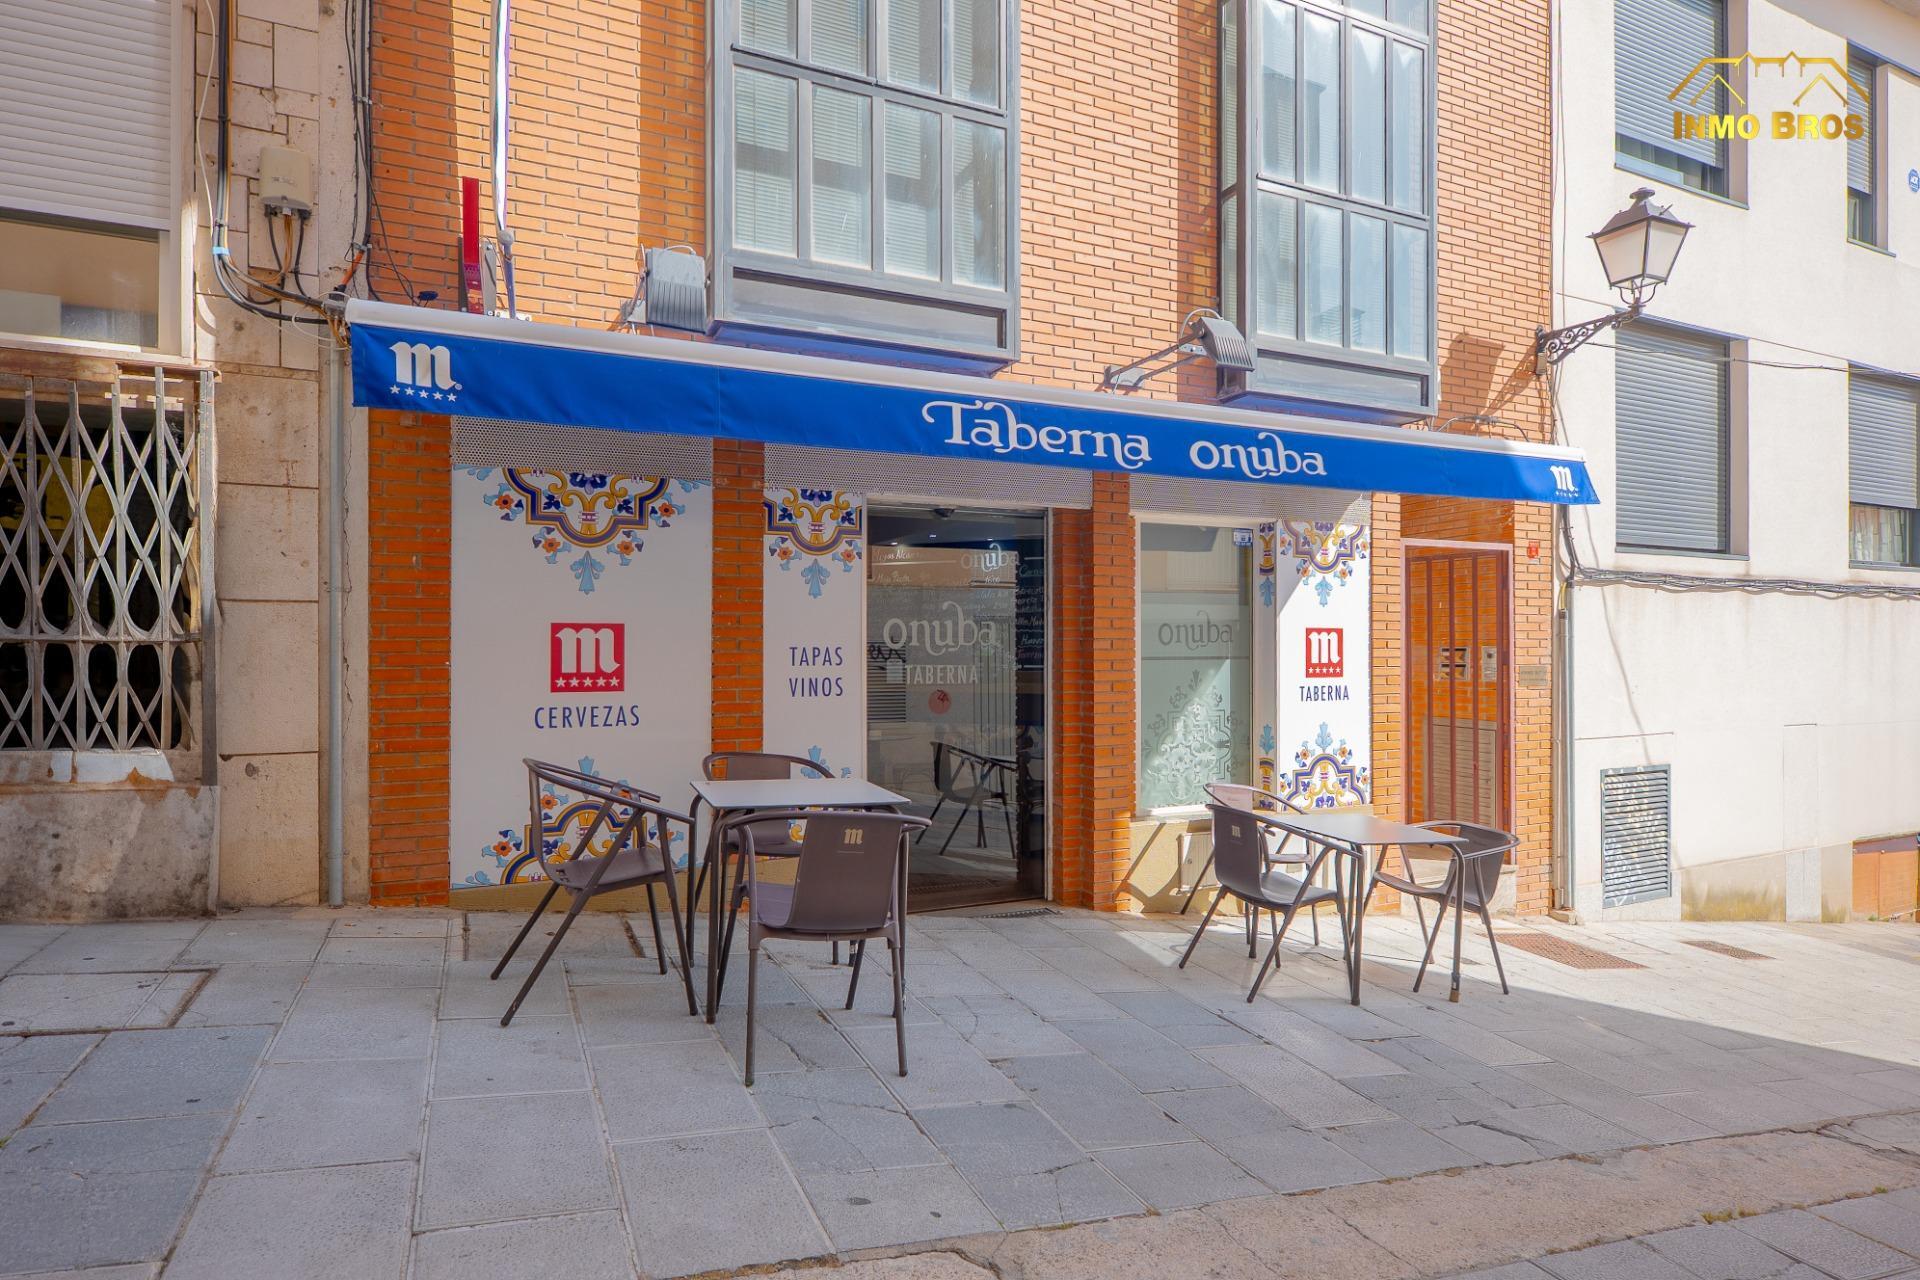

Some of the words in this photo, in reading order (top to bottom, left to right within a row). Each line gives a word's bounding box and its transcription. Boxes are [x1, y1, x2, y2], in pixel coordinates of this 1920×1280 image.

[921, 399, 1152, 470] Taberna
[1189, 432, 1328, 479] onuba
[882, 600, 1002, 657] onuba
[1157, 610, 1235, 651] onuba
[789, 646, 844, 667] TAPAS
[905, 664, 979, 686] TABERNA
[789, 677, 844, 698] VINOS
[1299, 685, 1350, 702] TABERNA
[534, 704, 640, 729] CERVEZAS
